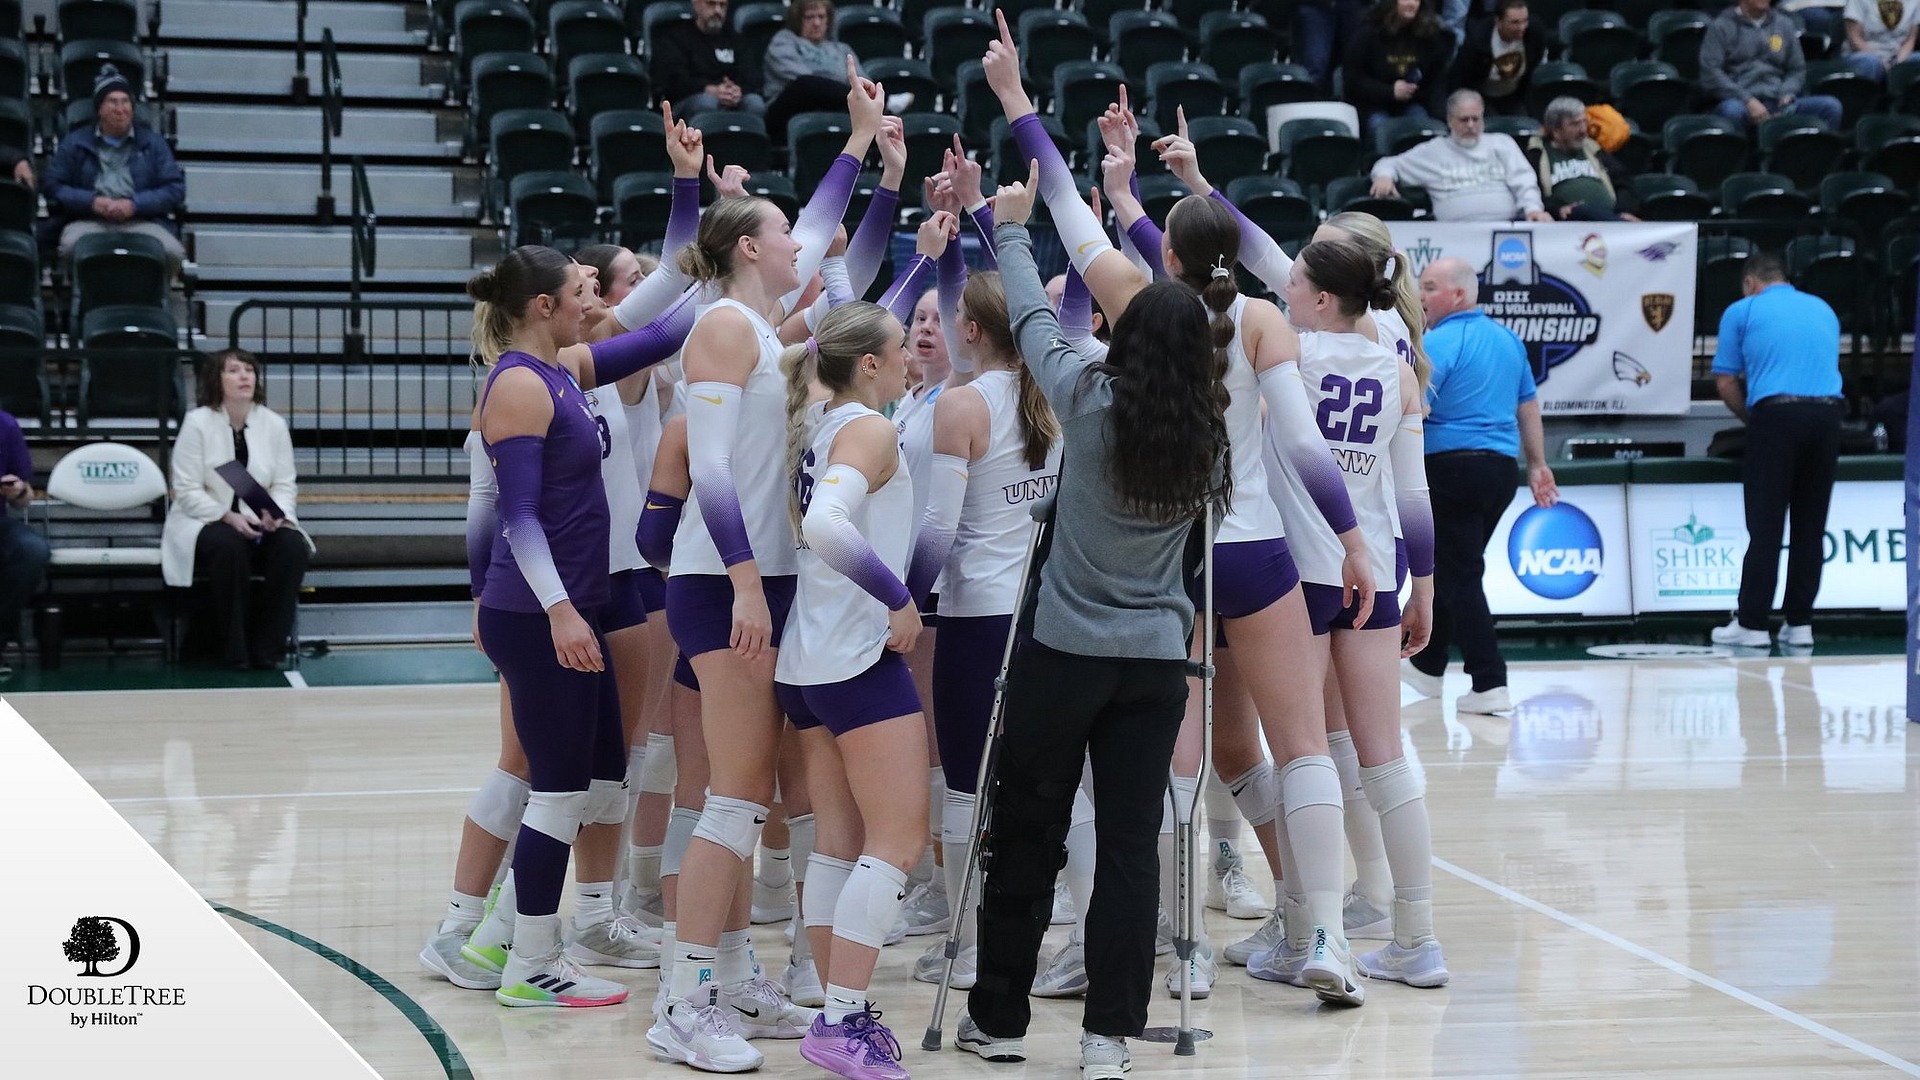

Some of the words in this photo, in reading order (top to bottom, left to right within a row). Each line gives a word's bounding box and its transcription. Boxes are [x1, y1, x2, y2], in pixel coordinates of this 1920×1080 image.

[1504, 303, 1577, 315] VOLLEYBALL
[1493, 317, 1597, 342] IONSHIP
[1316, 374, 1384, 444] 22
[78, 462, 140, 479] TITANS
[1517, 548, 1603, 577] NCAA
[1656, 546, 1736, 568] SHIRK
[1657, 572, 1740, 588] CENTER
